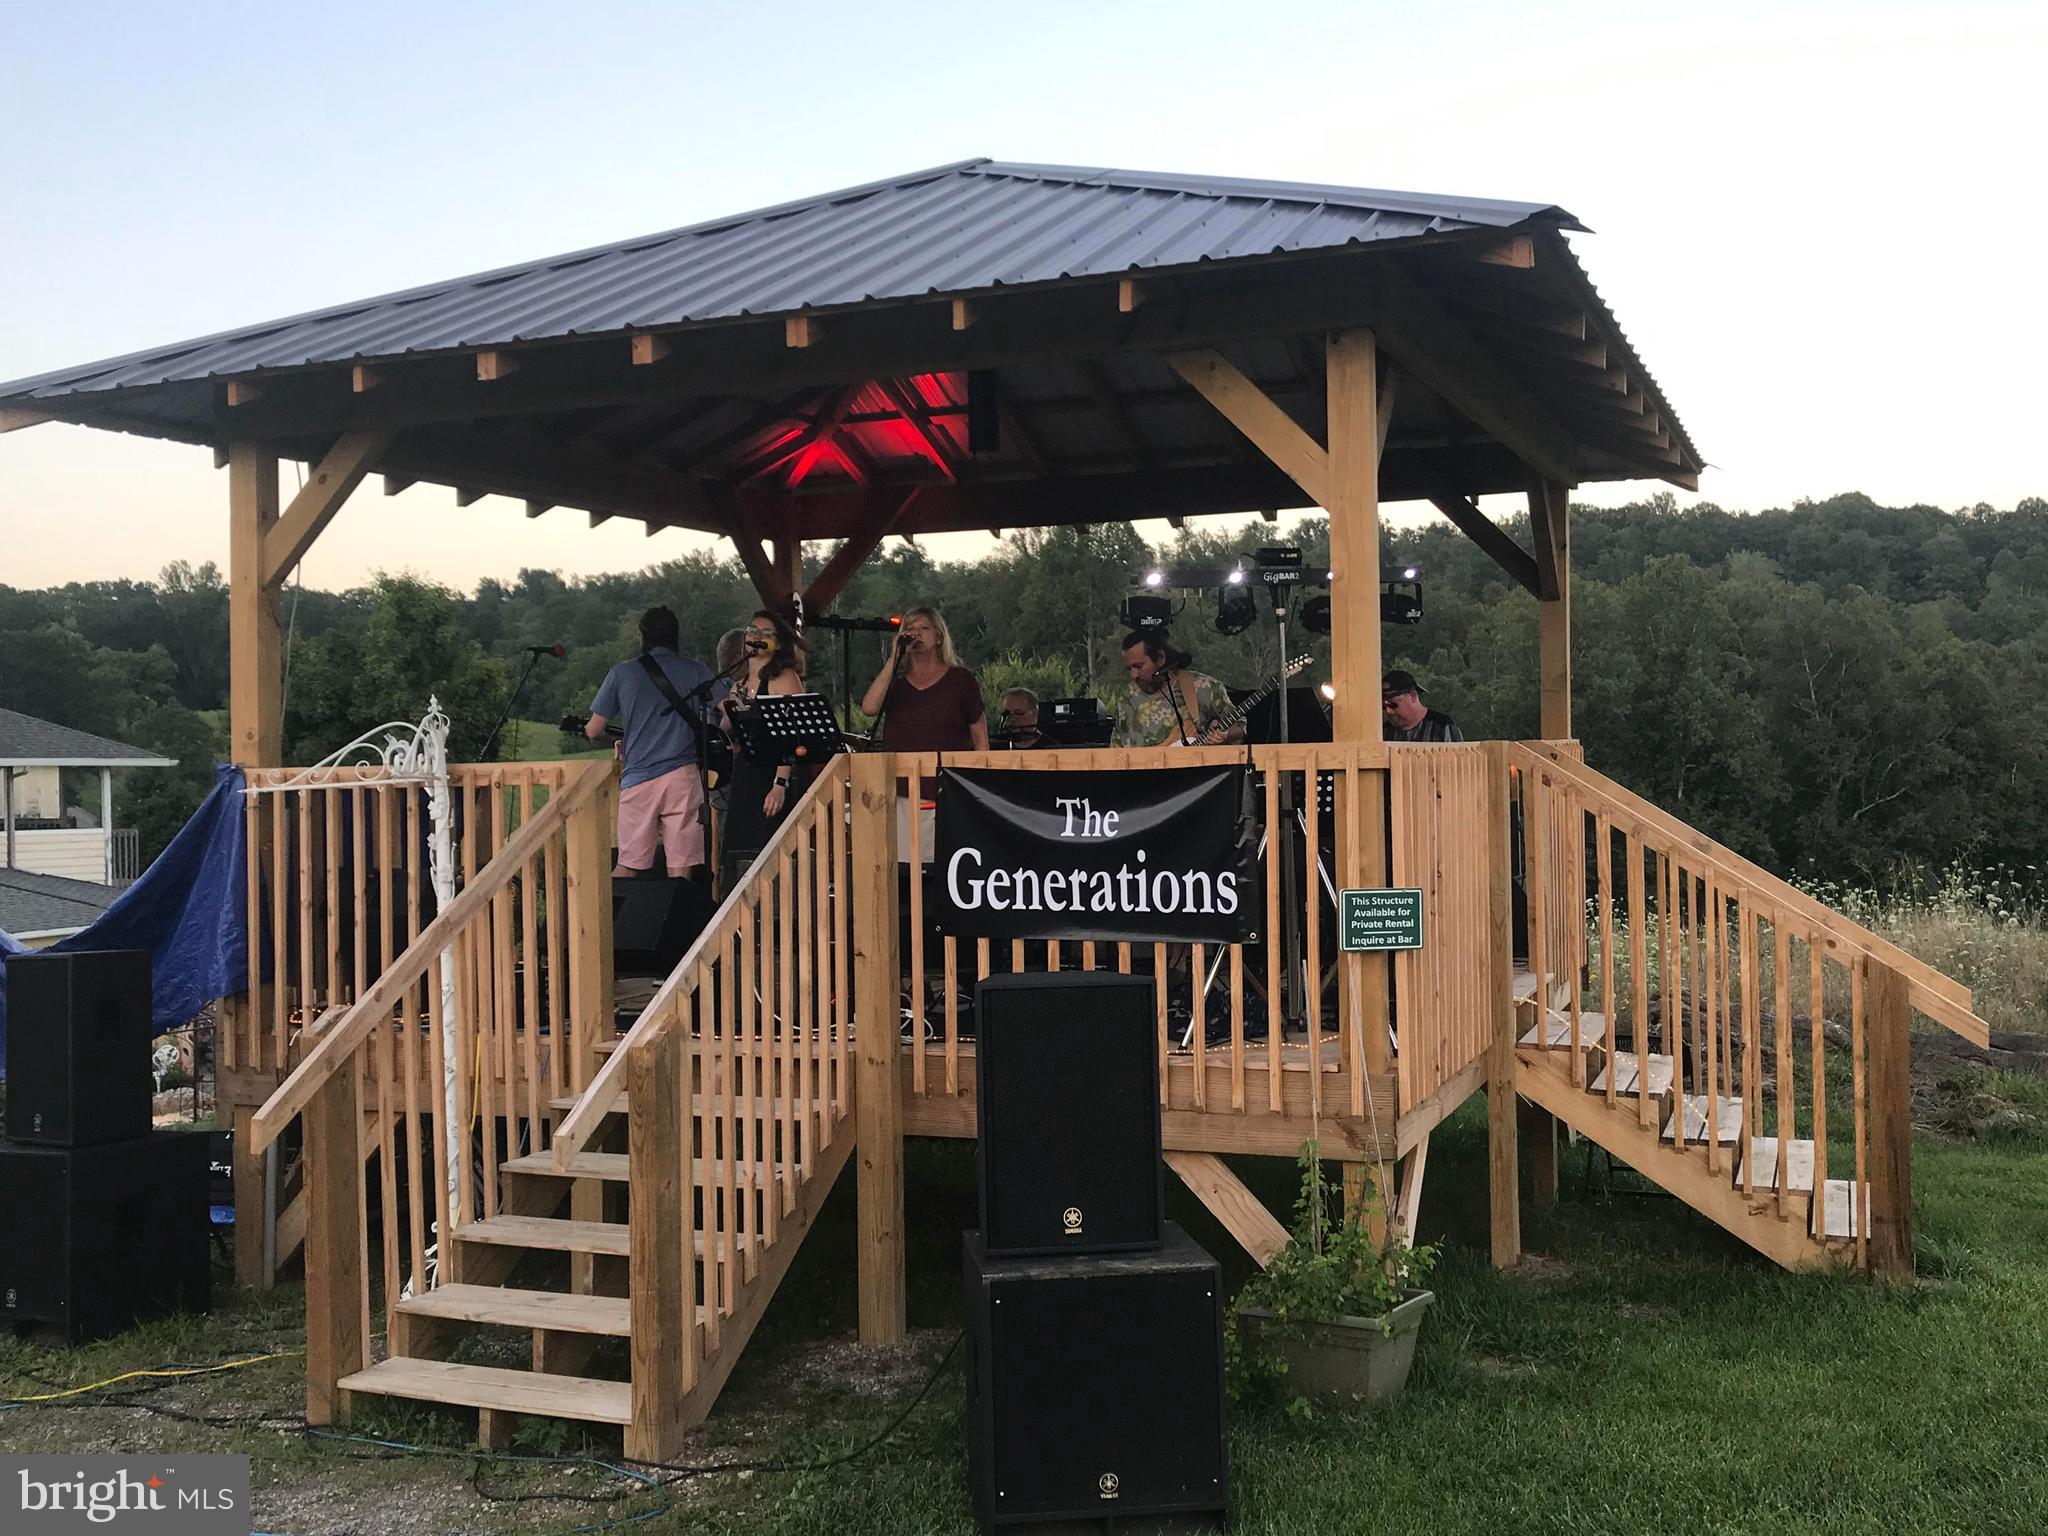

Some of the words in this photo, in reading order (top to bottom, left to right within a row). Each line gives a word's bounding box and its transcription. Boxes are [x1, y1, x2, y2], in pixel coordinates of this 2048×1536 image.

[1055, 796, 1120, 838] The
[947, 847, 1239, 914] Generations
[1351, 896, 1370, 906] This
[1371, 896, 1414, 905] Structure
[1353, 908, 1396, 917] Available
[1397, 907, 1411, 916] for
[1351, 919, 1383, 929] Private
[1385, 918, 1414, 928] Rental
[1352, 936, 1385, 946] Inquire
[1386, 936, 1396, 944] at
[1398, 935, 1414, 944] Bar
